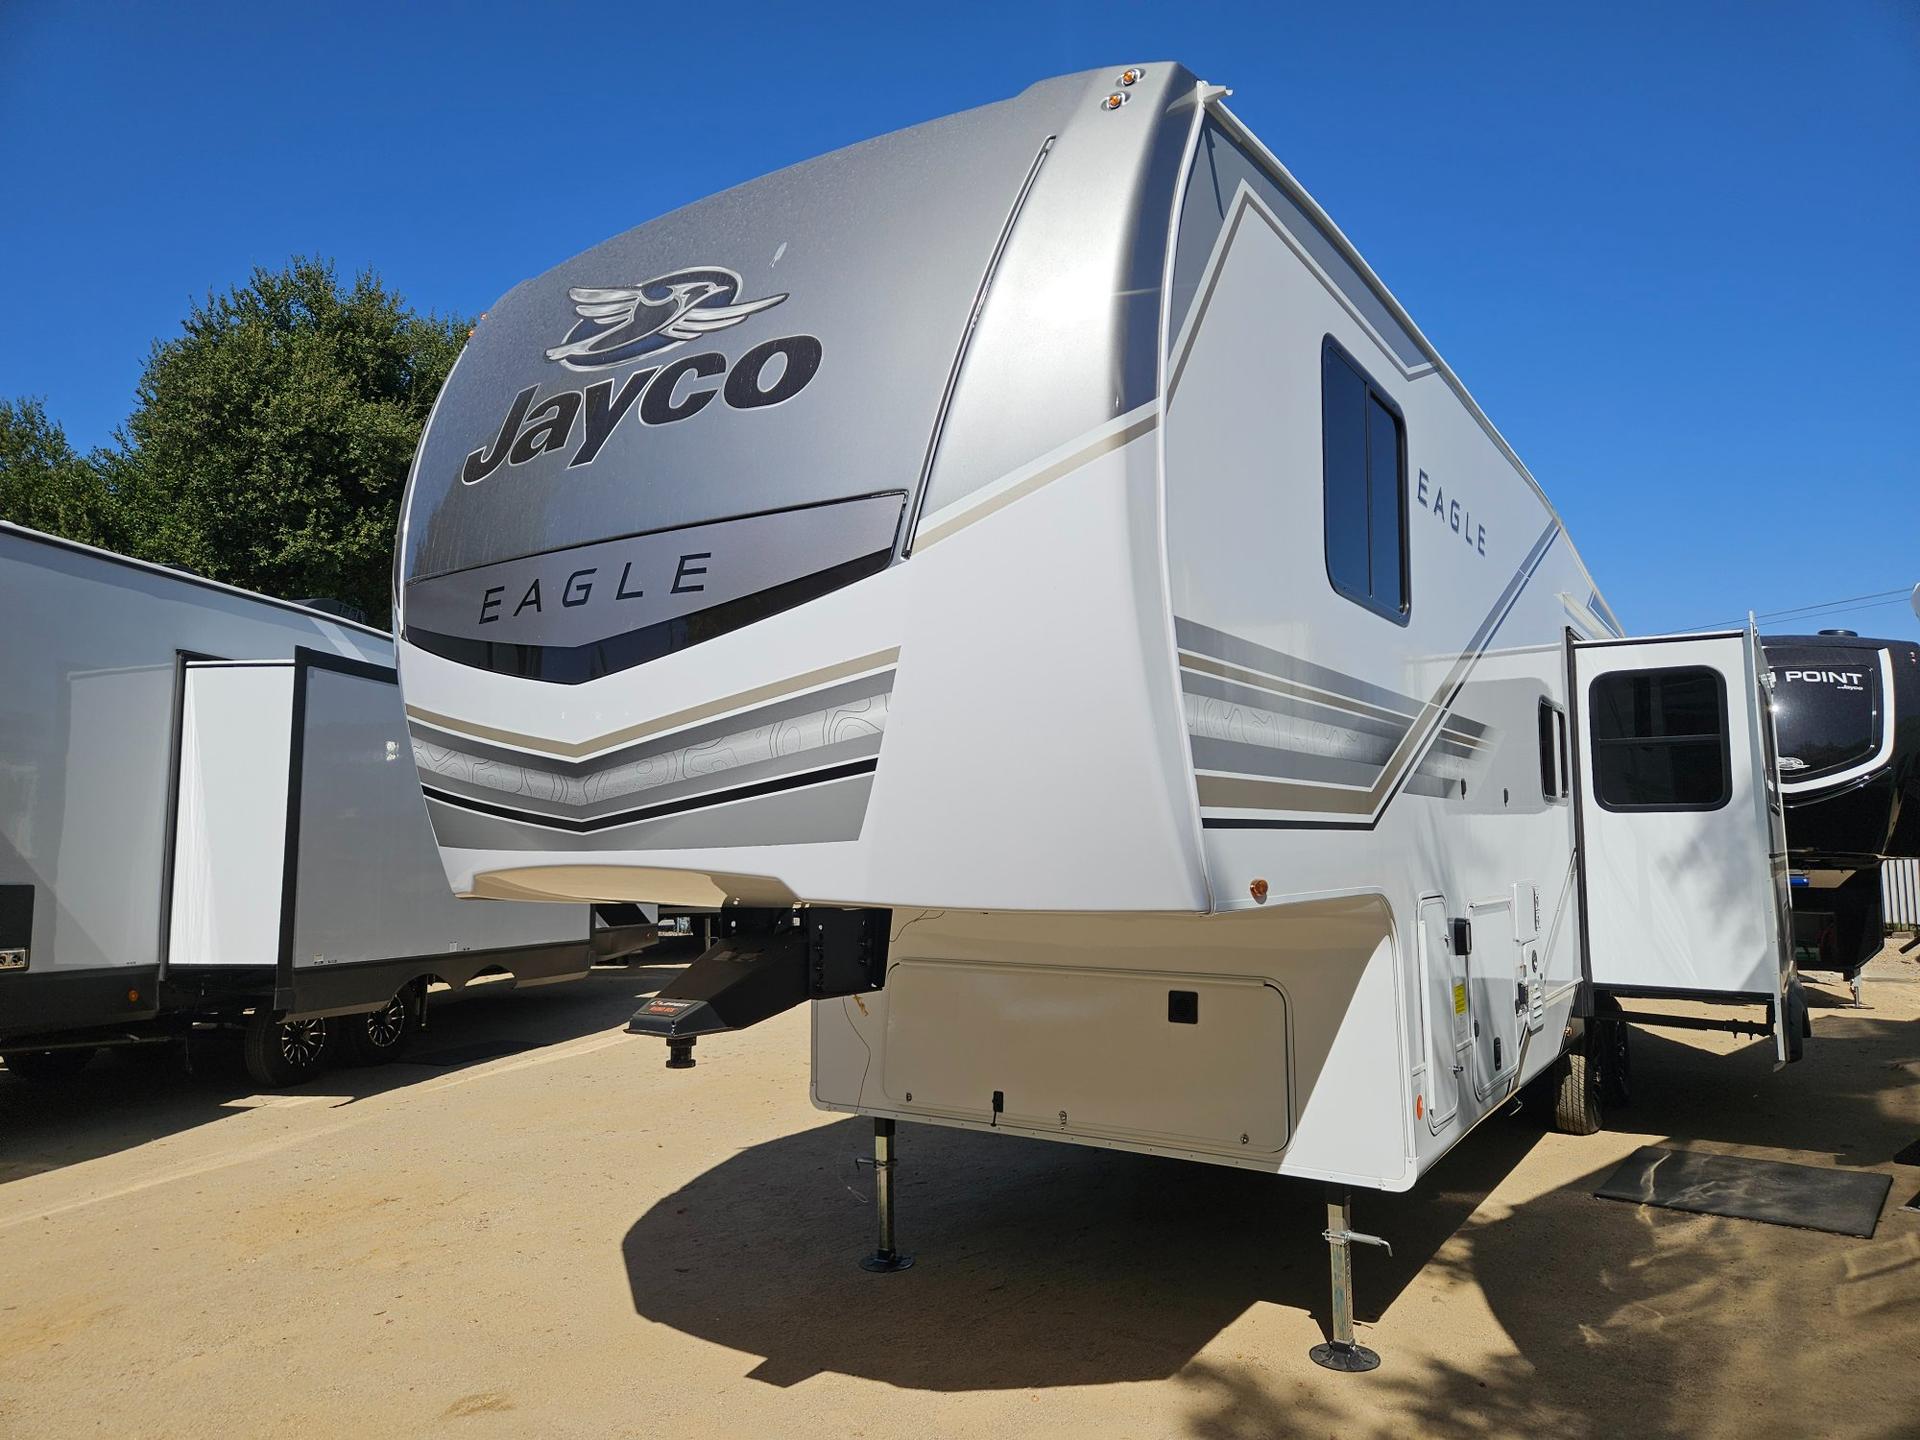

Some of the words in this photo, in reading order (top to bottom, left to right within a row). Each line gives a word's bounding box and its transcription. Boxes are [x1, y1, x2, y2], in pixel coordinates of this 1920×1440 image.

[461, 335, 823, 485] Jayco
[1417, 467, 1486, 558] EAGLE
[479, 552, 712, 625] EAGLE
[1785, 671, 1862, 684] POINT
